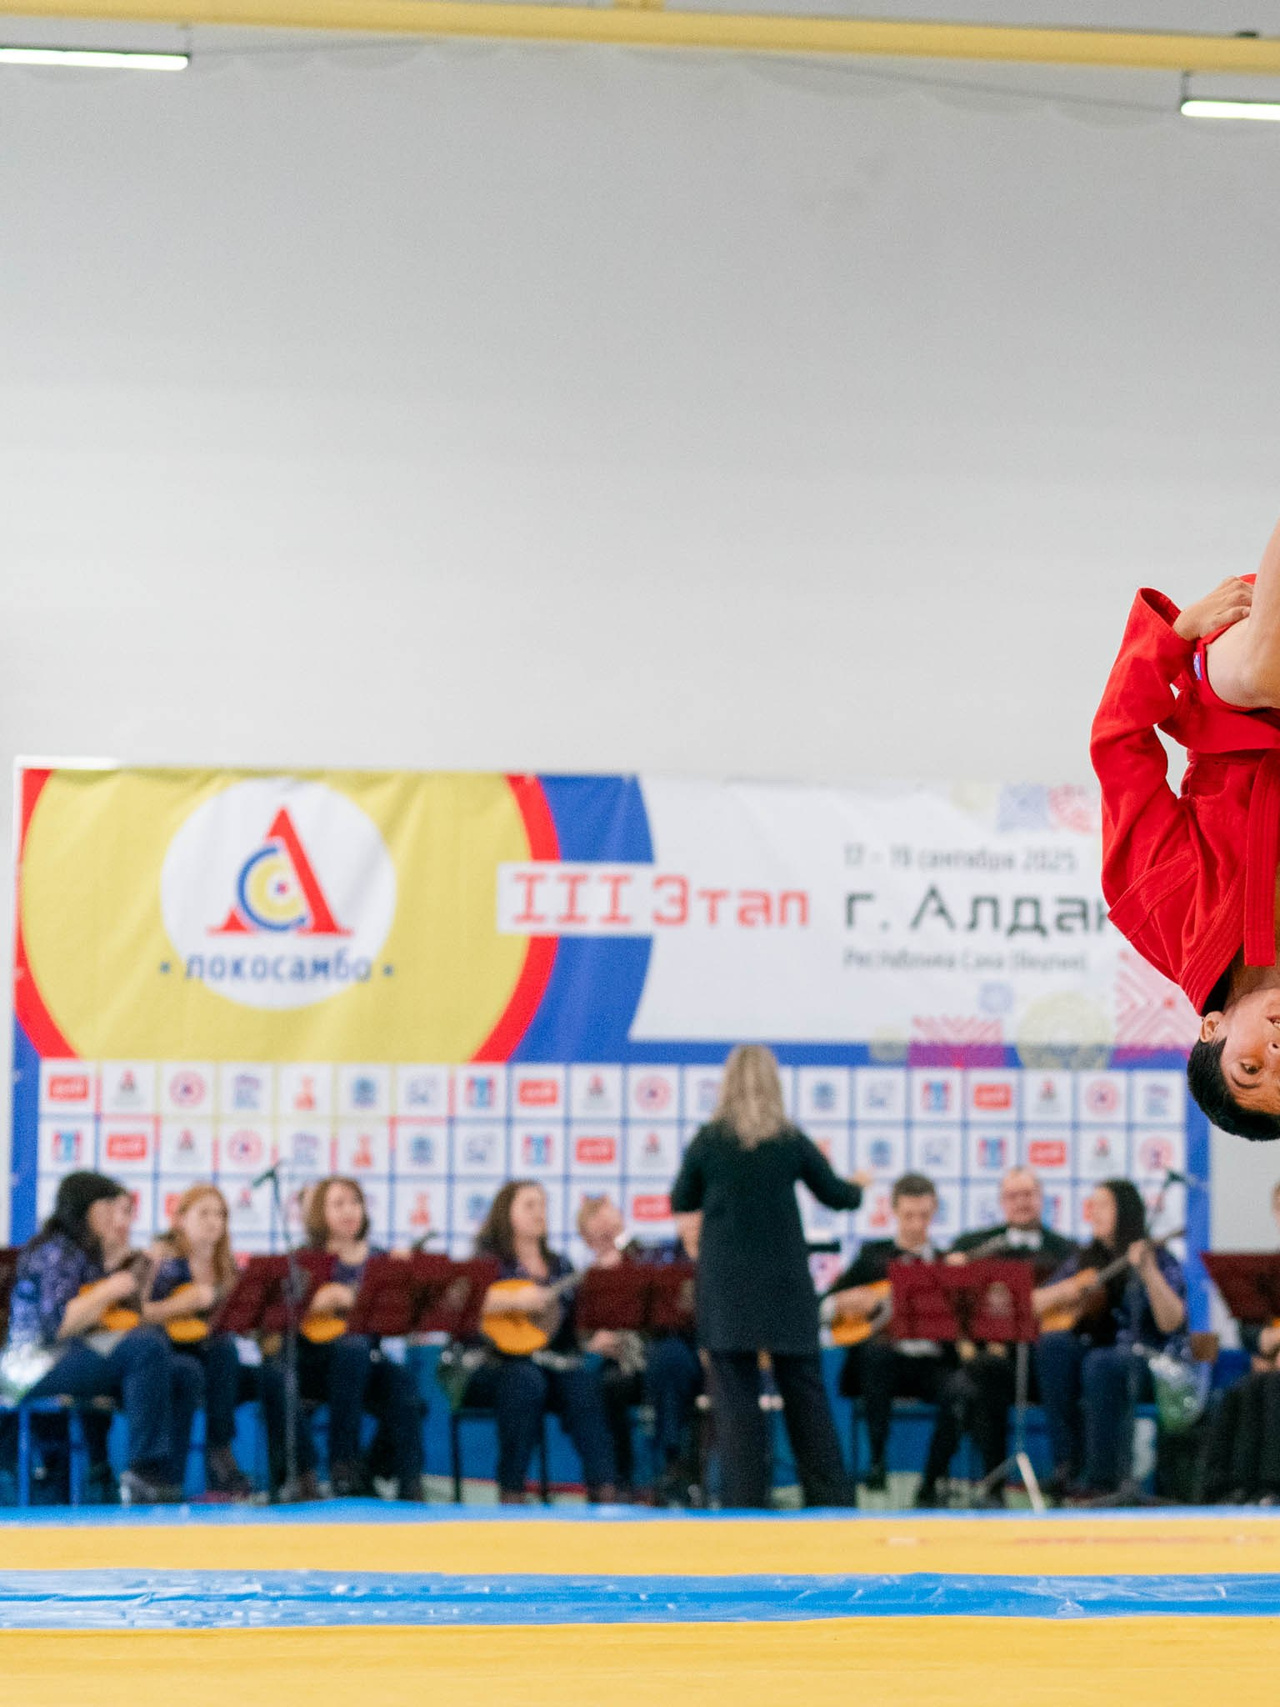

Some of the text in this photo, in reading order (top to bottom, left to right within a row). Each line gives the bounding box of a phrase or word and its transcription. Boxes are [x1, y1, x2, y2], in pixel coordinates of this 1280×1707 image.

[918, 844, 1014, 872] сентября
[513, 872, 810, 927] III Этап
[846, 892, 889, 931] г.
